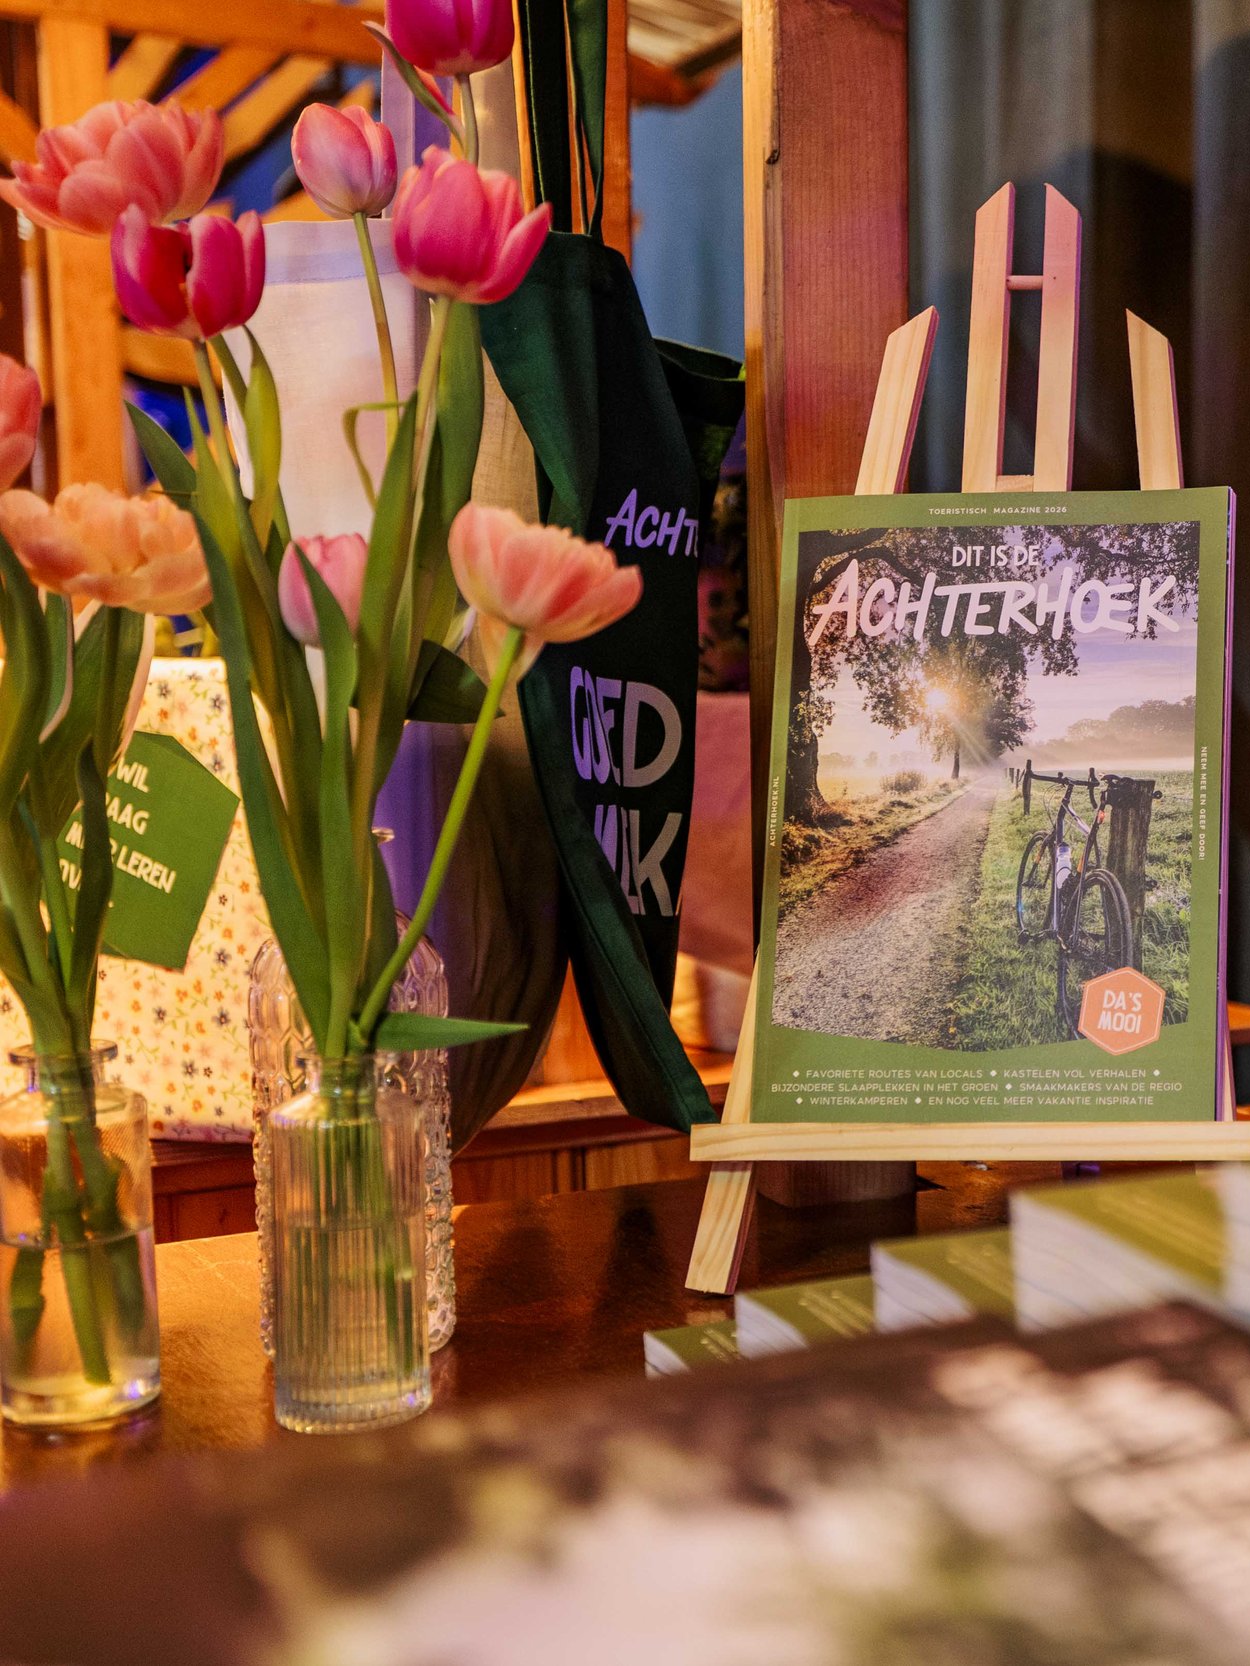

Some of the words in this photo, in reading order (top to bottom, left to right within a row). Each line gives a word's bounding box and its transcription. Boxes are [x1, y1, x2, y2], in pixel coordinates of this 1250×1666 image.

[928, 507, 987, 515] TOERISTISCH
[993, 506, 1041, 514] MAGAZINE
[1044, 506, 1067, 514] 2026
[603, 488, 699, 558] ACHT
[952, 545, 985, 567] DIT
[990, 545, 1009, 567] IS
[1013, 545, 1041, 567] DE
[808, 558, 1180, 646] ACHTERHOEK
[1200, 745, 1208, 770] NEEM
[116, 756, 149, 793] WIL
[1199, 793, 1207, 805] EN
[769, 776, 780, 847] ACHTERHOEK.NL
[116, 845, 177, 894] LEREN
[1102, 989, 1143, 1012] DA'S
[1097, 1010, 1142, 1034] MOOI
[806, 1069, 865, 1079] FAVORIETE
[868, 1069, 912, 1079] ROUTES
[915, 1069, 938, 1079] VAN
[940, 1069, 983, 1079] LOCALS
[1003, 1069, 1060, 1078] KASTELEN
[1063, 1069, 1085, 1078] VOL
[1089, 1069, 1146, 1078] VERHALEN
[771, 1083, 834, 1092] BIJZONDERE
[838, 1083, 920, 1092] SLAAPPLEKKEN
[923, 1083, 934, 1092] IN
[937, 1083, 959, 1092] HET
[961, 1082, 999, 1092] GROEN
[1019, 1082, 1101, 1092] SMAAKMAKERS
[1105, 1082, 1128, 1092] VAN
[1131, 1082, 1146, 1092] DE
[1149, 1082, 1183, 1091] REGIO
[809, 1096, 908, 1106] WINTERKAMPEREN
[928, 1096, 943, 1105] EN
[946, 1096, 970, 1105] NOG
[972, 1096, 1000, 1105] VEEL
[1003, 1096, 1034, 1105] MEER
[1037, 1096, 1091, 1105] VAKANTIE
[1095, 1096, 1154, 1105] INSPIRATIE
